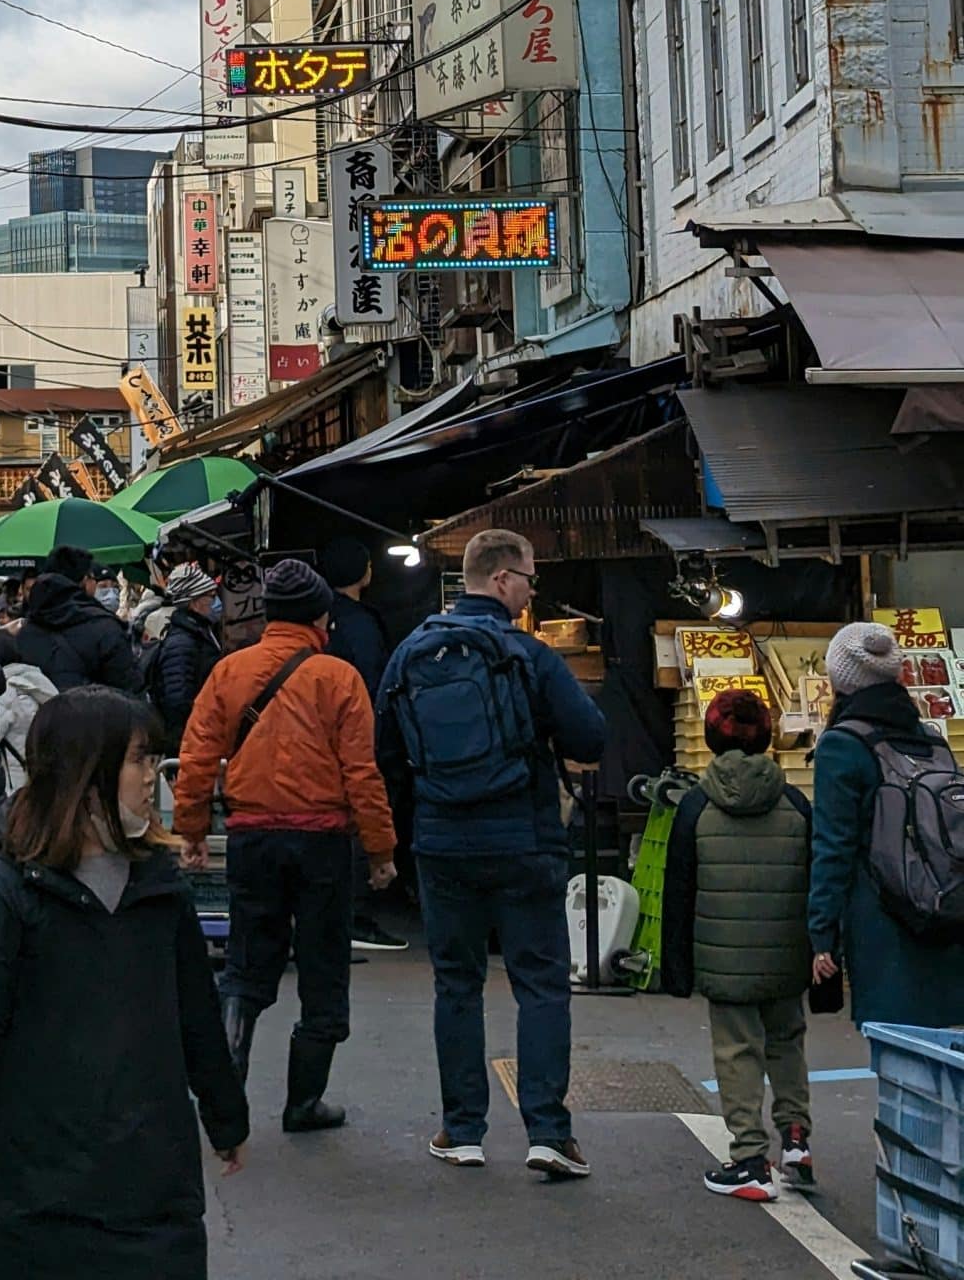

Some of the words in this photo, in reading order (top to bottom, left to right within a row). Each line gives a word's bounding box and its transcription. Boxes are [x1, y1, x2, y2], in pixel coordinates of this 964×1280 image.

[254, 50, 366, 90] ホタテ
[284, 180, 296, 214] コウチ
[191, 198, 212, 285] 中華幸軒
[291, 248, 318, 339] よすが庵
[184, 313, 213, 365] 茶
